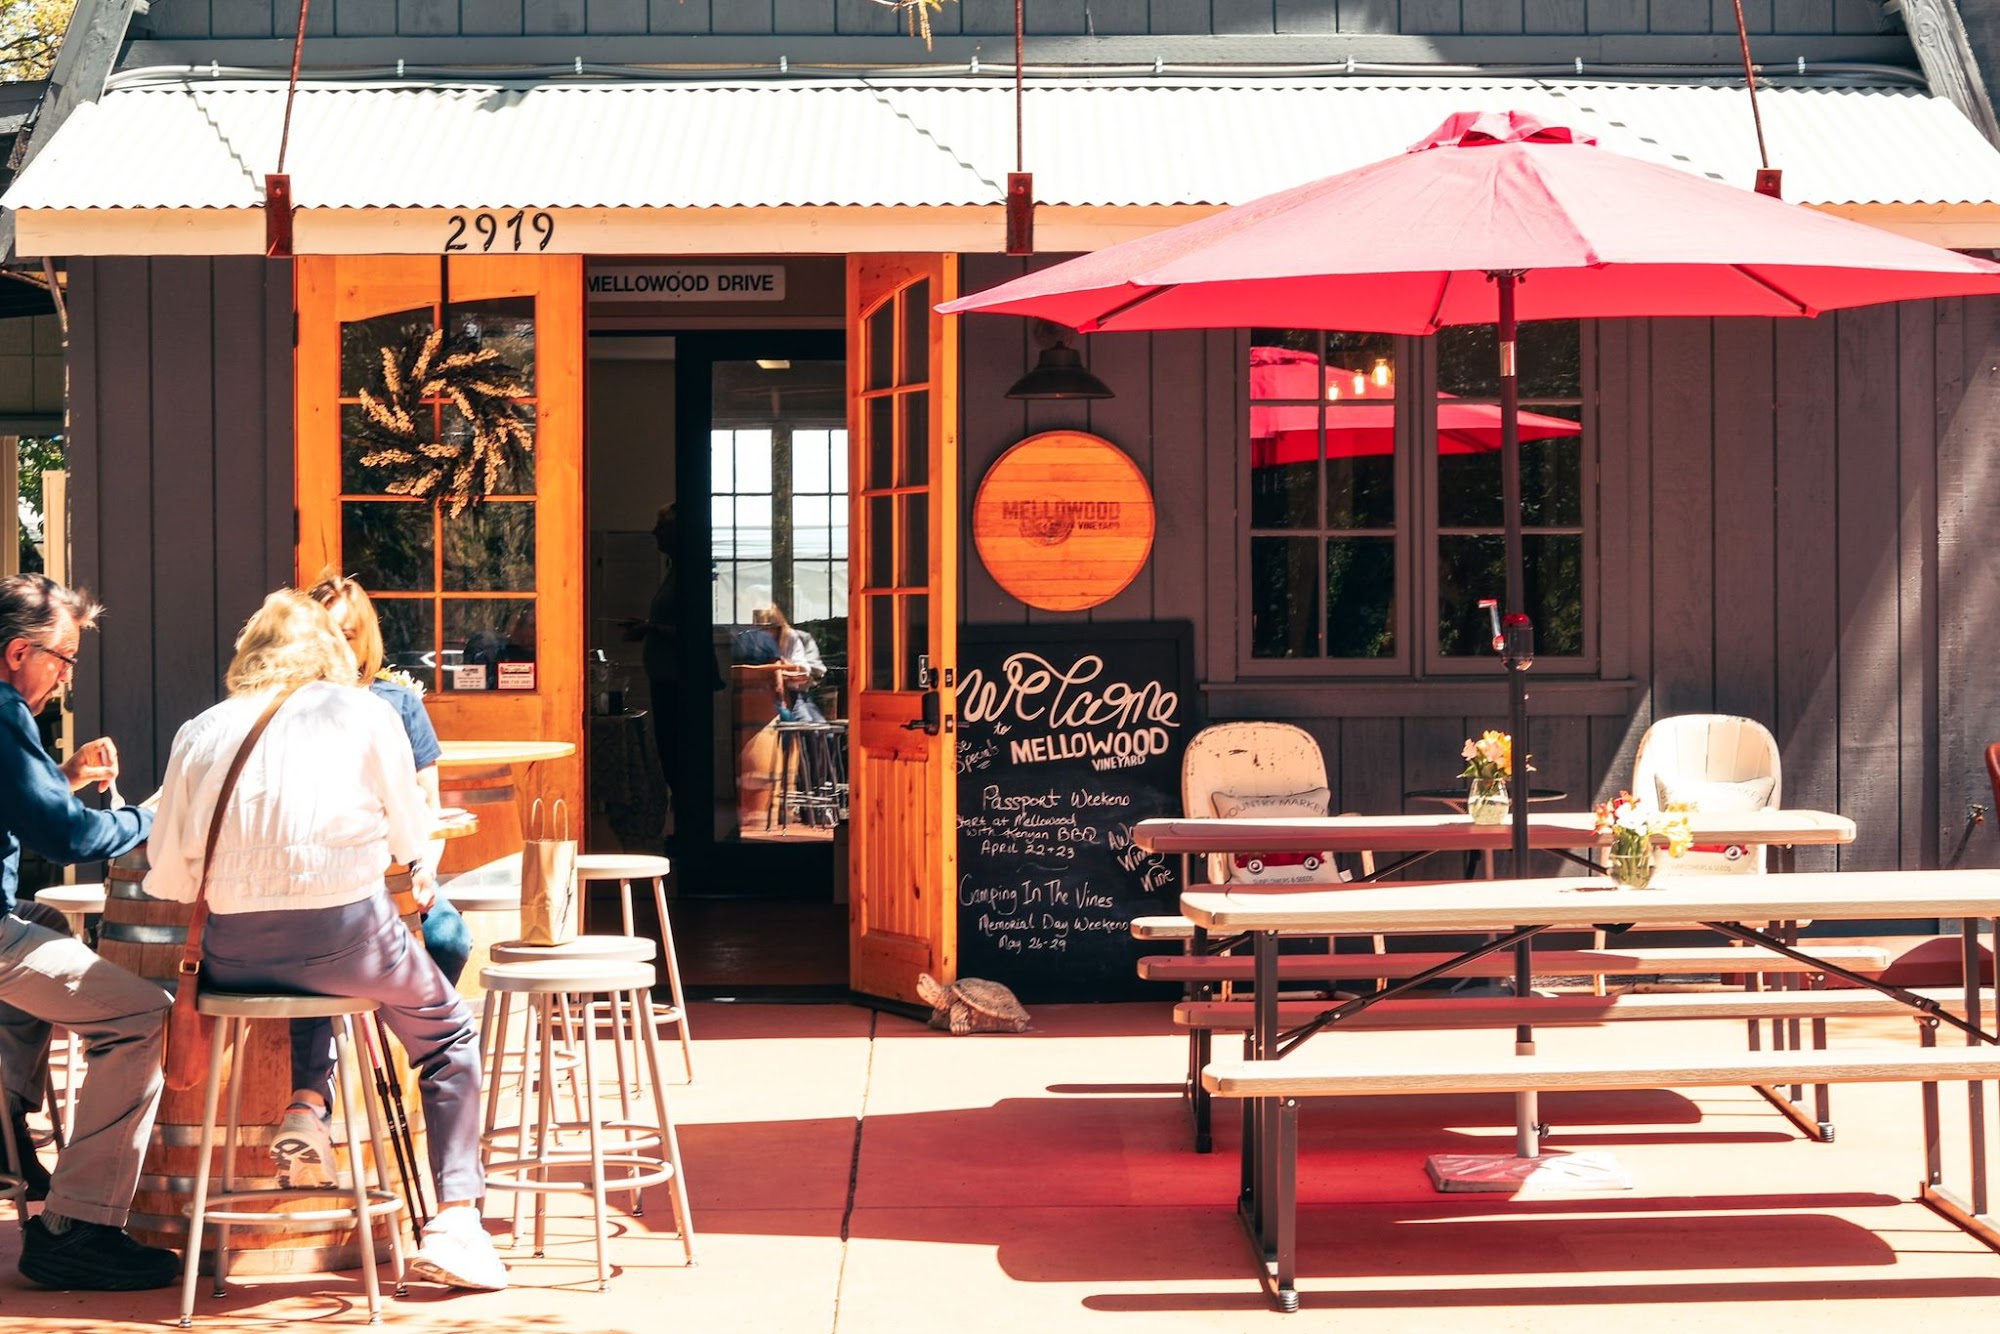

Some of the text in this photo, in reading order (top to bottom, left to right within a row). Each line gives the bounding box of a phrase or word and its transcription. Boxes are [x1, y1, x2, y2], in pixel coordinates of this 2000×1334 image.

[445, 210, 555, 252] 2919
[587, 274, 774, 293] MELLOWOOD DRIVE
[1002, 501, 1121, 520] MELLOWOOD
[992, 721, 1013, 736] to
[1010, 726, 1170, 765] MELLOWOOD
[1091, 754, 1147, 772] VINEYARD
[992, 816, 1010, 827] at
[1014, 811, 1077, 828] Mellowood
[1057, 826, 1101, 845] BBQ
[1140, 864, 1176, 892] Wine
[958, 873, 1114, 916] Camping In The Vines
[1042, 913, 1070, 938] Day
[998, 934, 1022, 954] May
